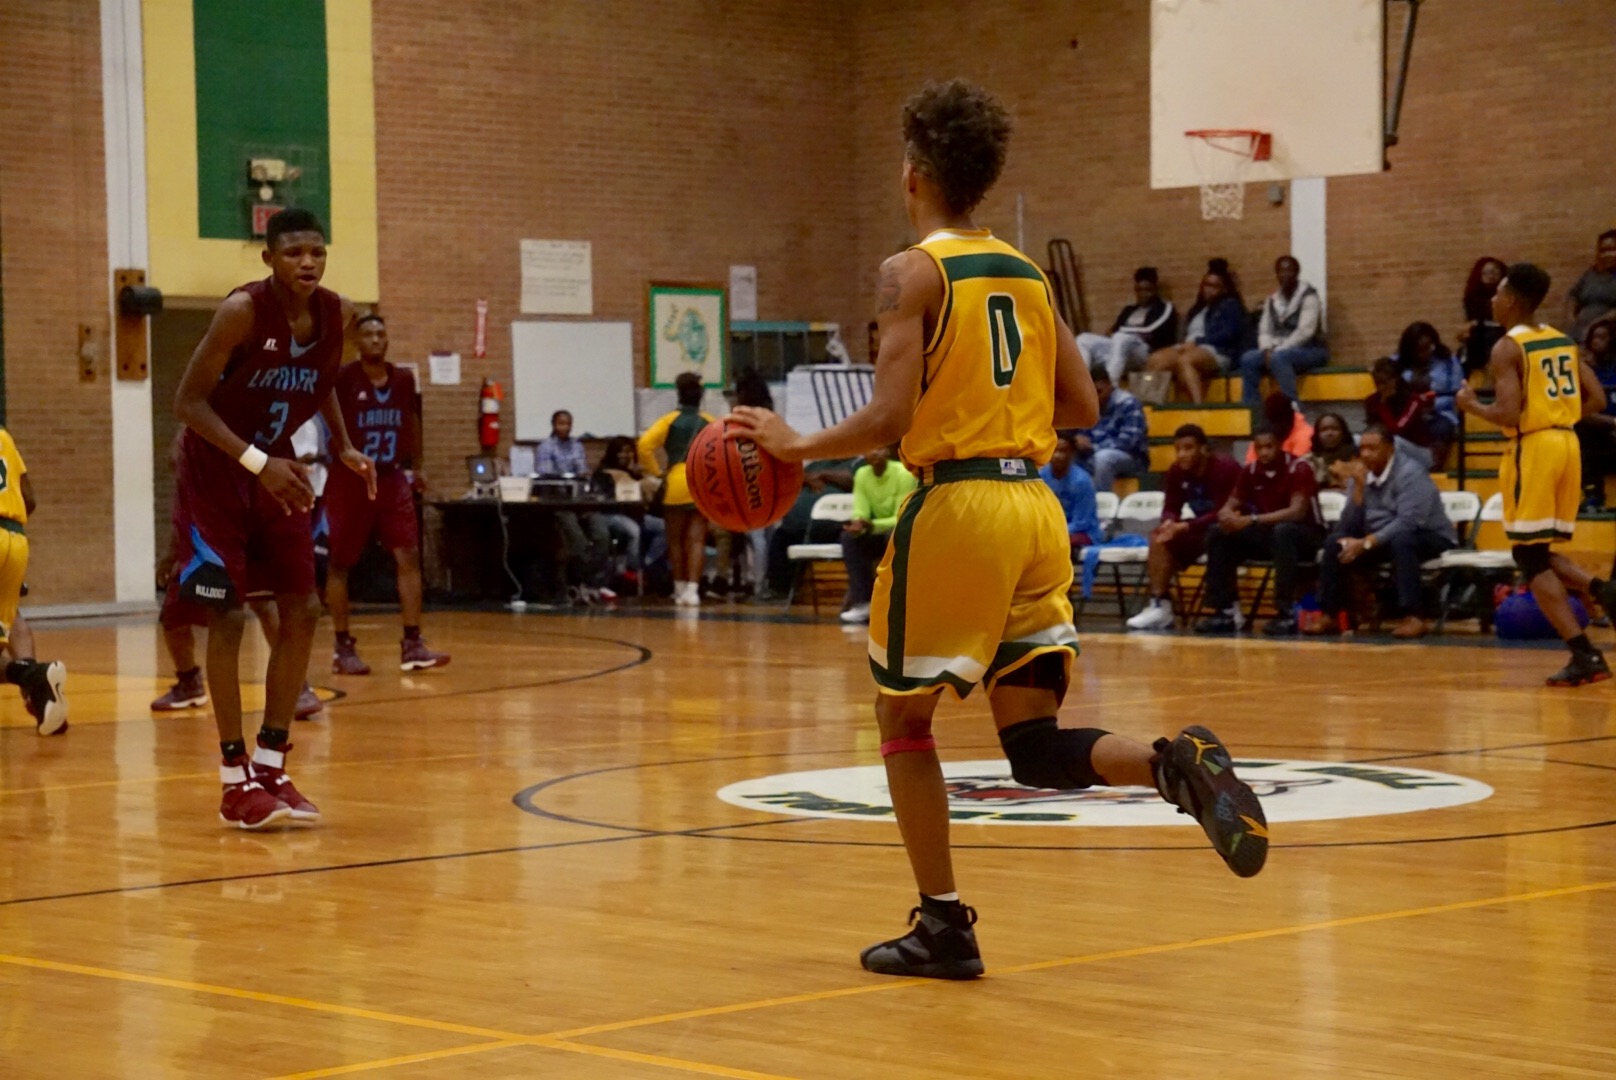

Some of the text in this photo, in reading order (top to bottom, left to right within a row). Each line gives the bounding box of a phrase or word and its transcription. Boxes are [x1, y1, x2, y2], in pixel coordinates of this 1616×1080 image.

[986, 293, 1024, 389] 0
[248, 367, 318, 394] LANIER
[1541, 355, 1576, 398] 35
[255, 401, 289, 445] 3
[363, 431, 396, 461] 23
